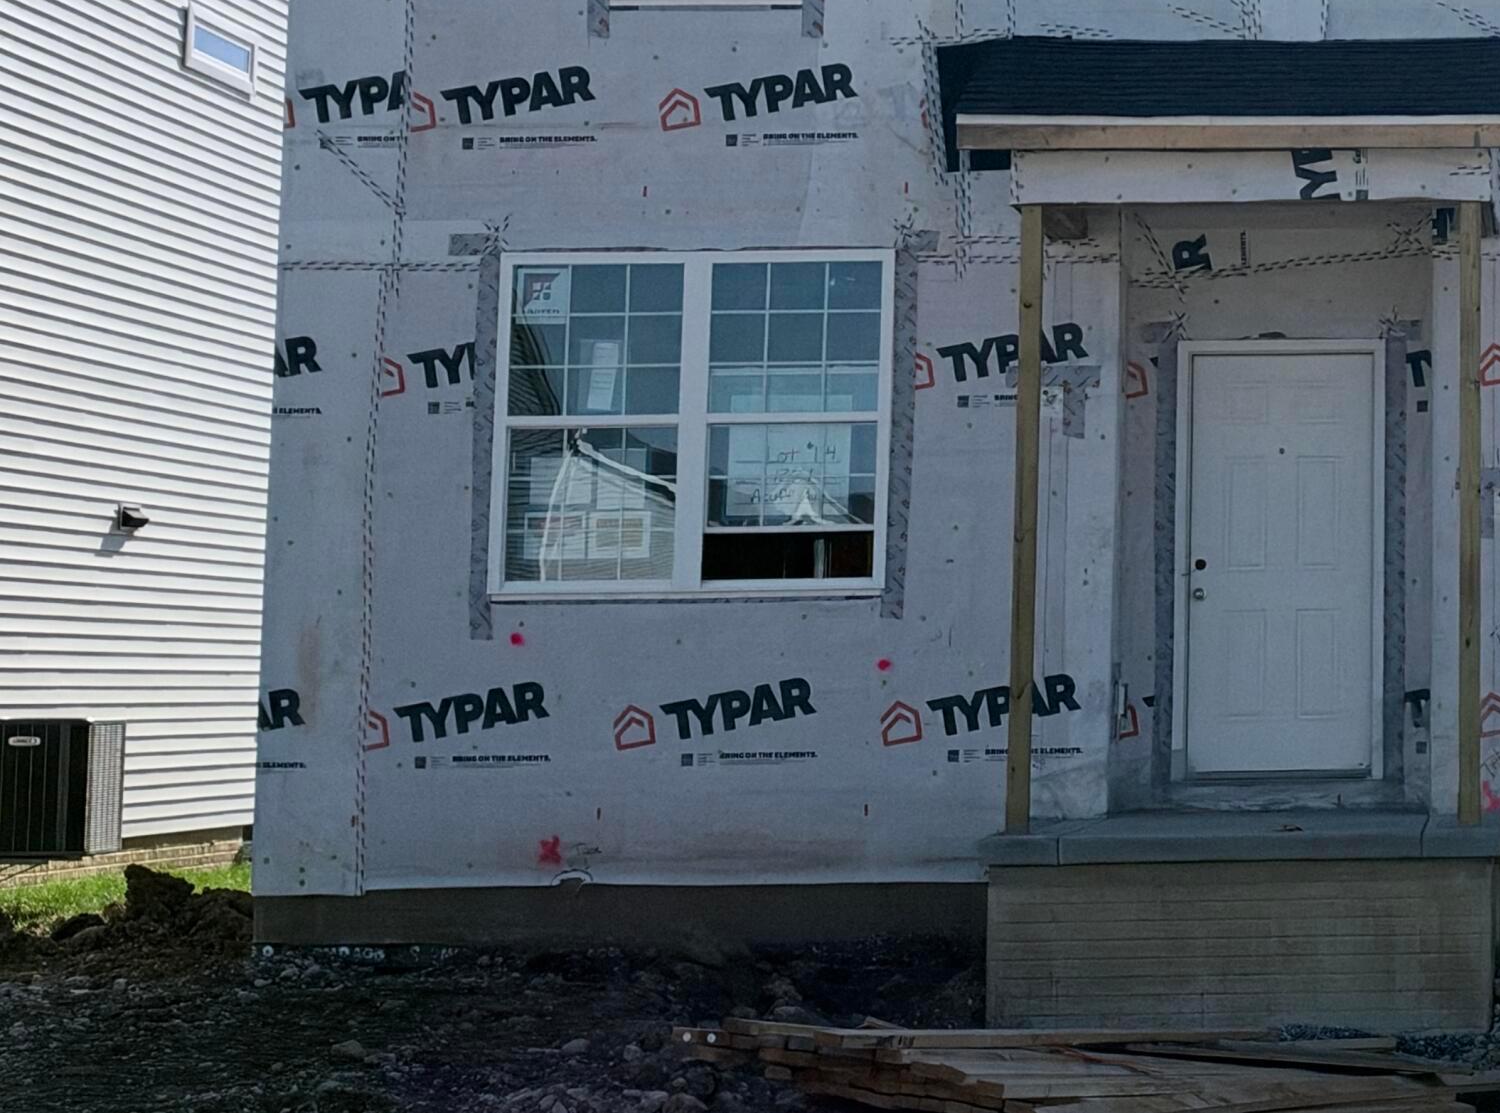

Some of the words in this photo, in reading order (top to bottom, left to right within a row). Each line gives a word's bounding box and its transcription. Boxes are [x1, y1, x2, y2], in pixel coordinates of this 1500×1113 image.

[440, 66, 595, 124] TYPAR
[704, 64, 858, 121] TYPAR
[393, 682, 549, 742] TYPAR
[660, 678, 816, 739] TYPAR
